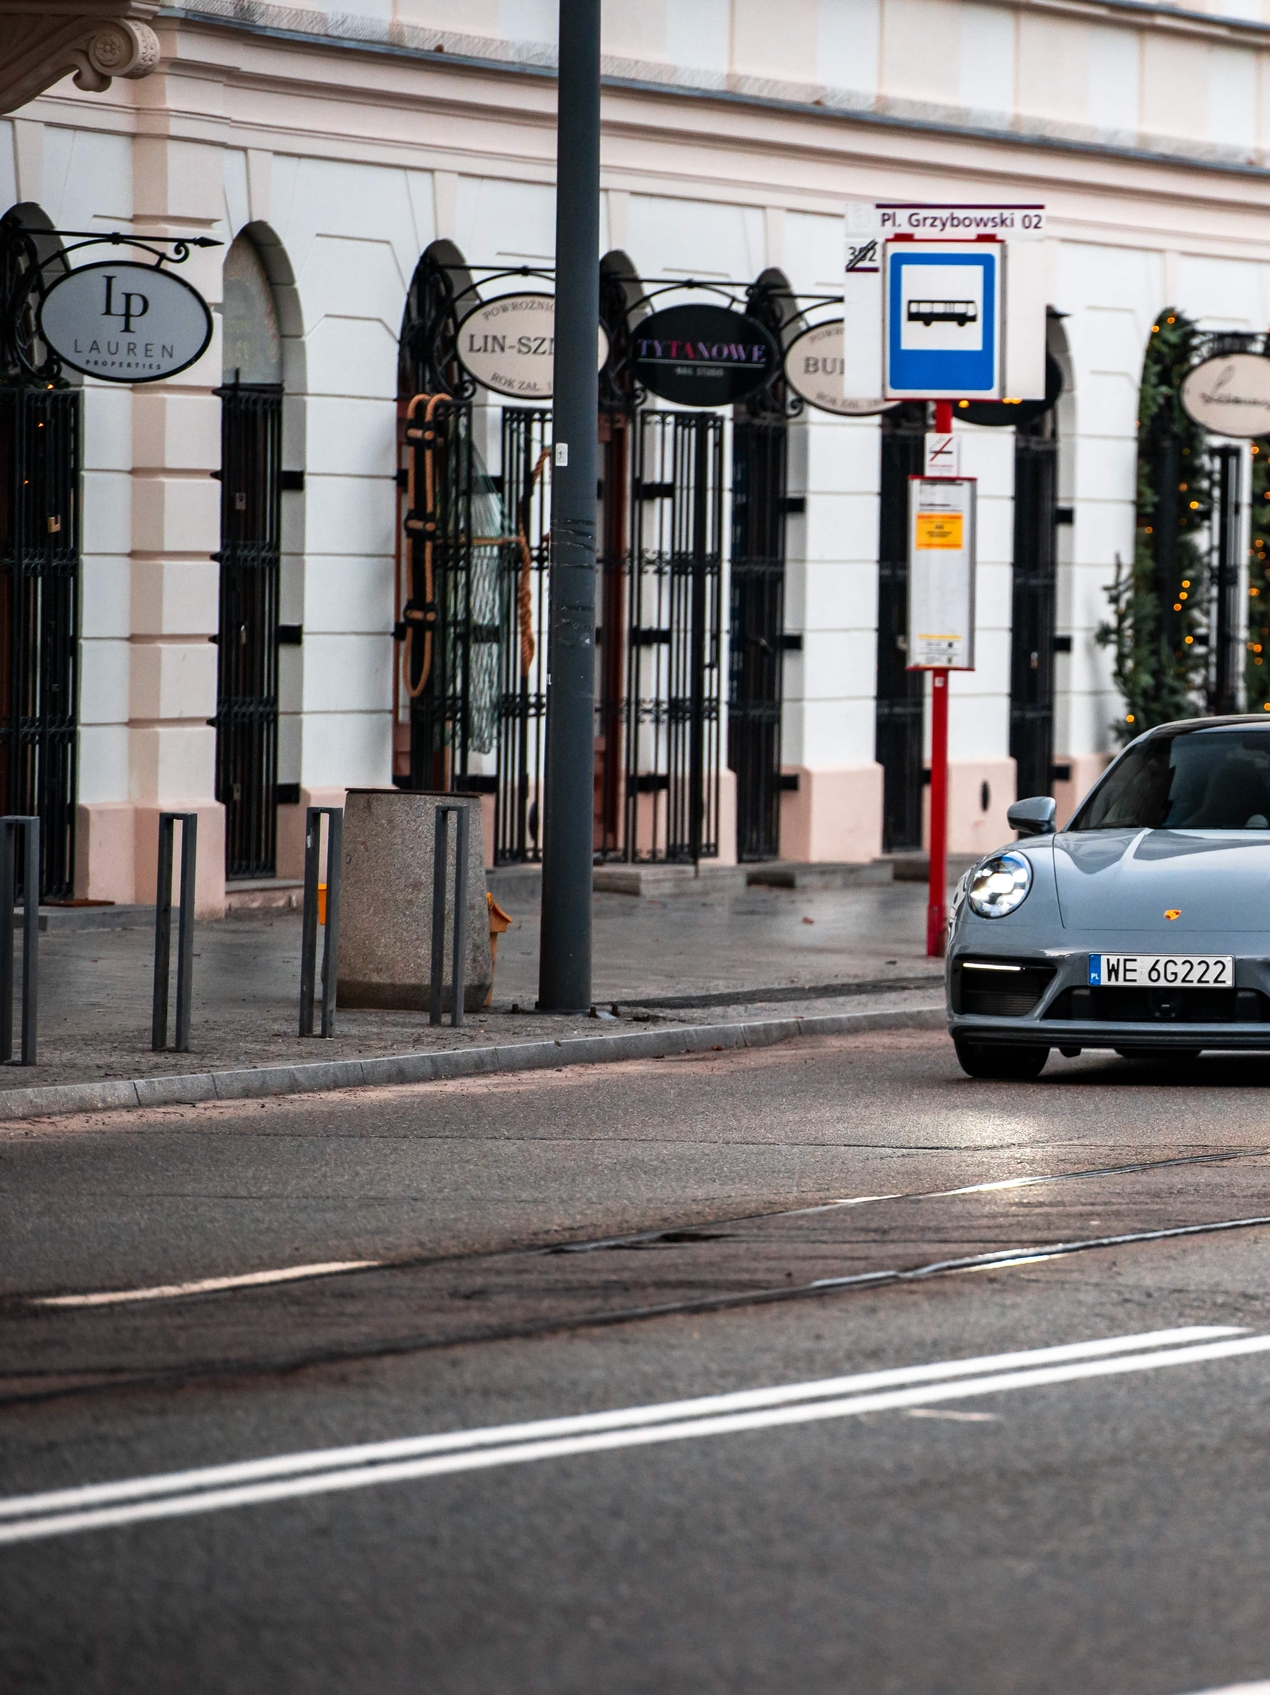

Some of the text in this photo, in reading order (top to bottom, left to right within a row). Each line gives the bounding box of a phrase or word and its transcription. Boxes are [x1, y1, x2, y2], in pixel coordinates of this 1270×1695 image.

[881, 212, 1043, 232] Pl. Grzybowski 02
[74, 338, 174, 358] LAUREN
[637, 339, 766, 363] TYTANOWE
[85, 359, 161, 370] PROPERTIES
[1091, 958, 1226, 984] PL WE 6G222
